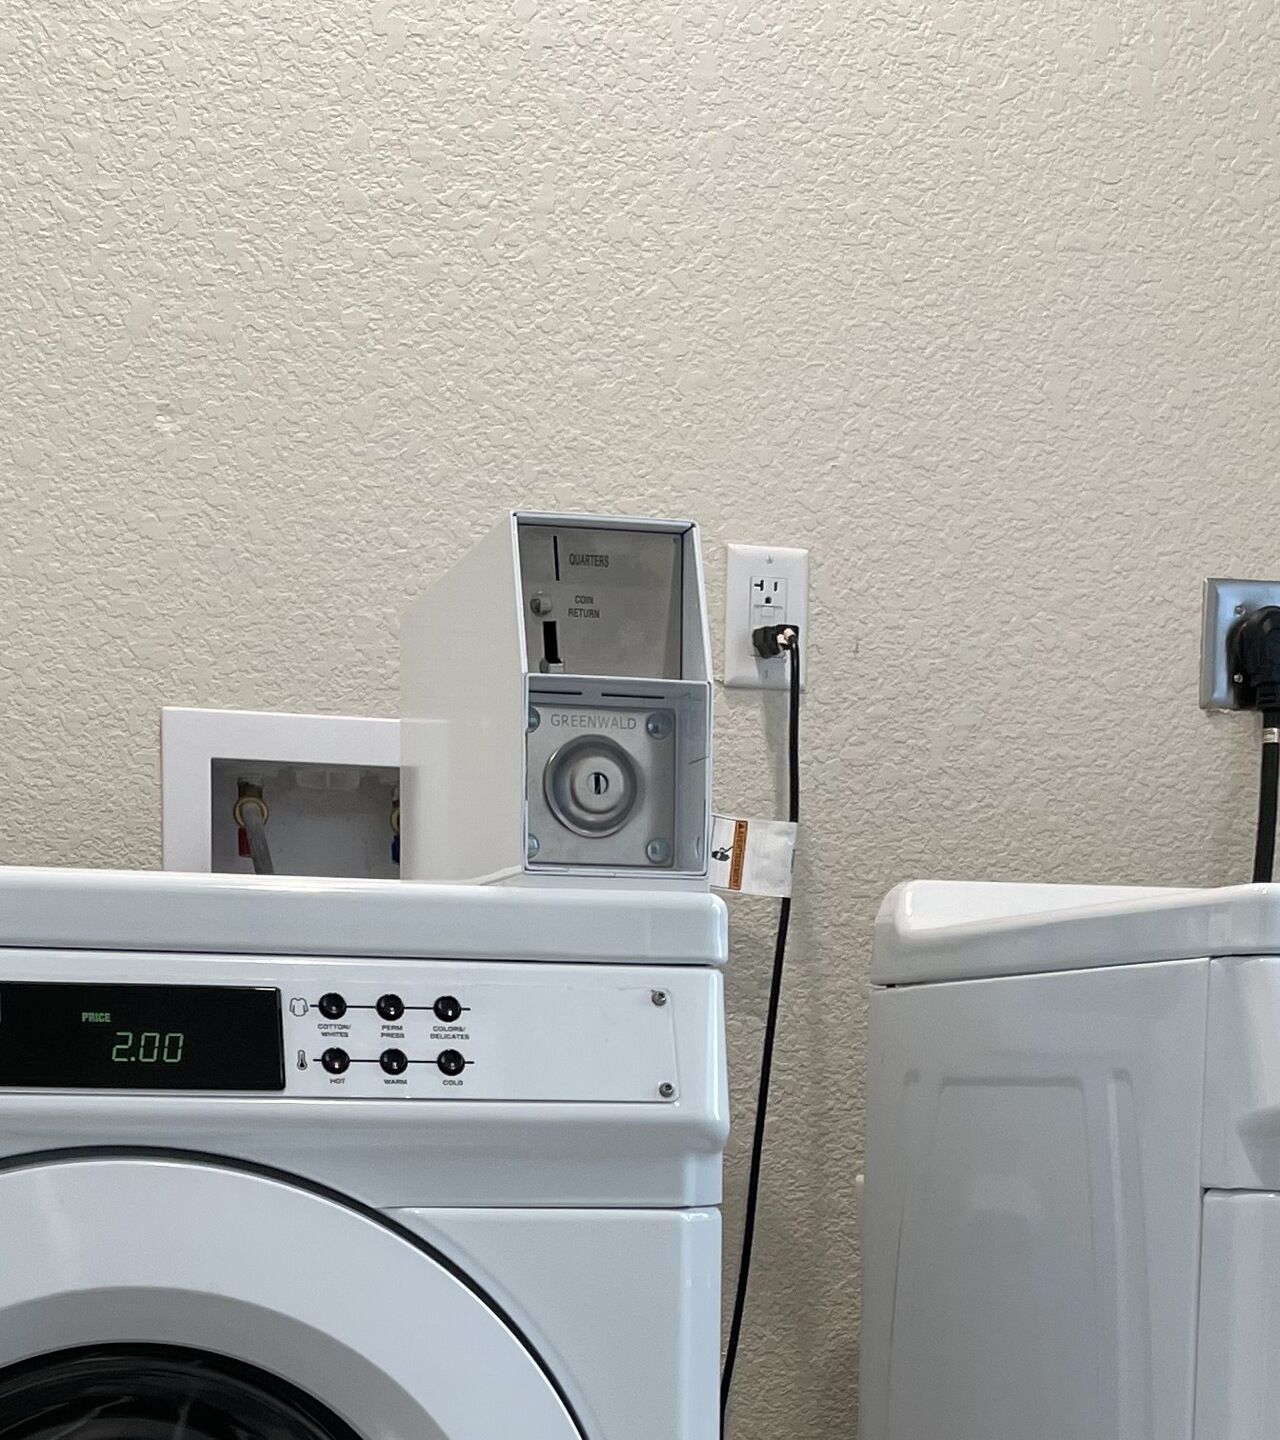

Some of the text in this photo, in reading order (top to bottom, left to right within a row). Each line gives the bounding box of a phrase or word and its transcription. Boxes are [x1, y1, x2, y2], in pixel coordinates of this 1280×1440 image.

[569, 553, 609, 568] QUARTERS
[574, 595, 594, 604] COIN
[568, 607, 600, 619] RETURN
[550, 713, 637, 730] GREENWALD
[81, 1012, 111, 1023] PRICE
[112, 1031, 185, 1063] 2.00
